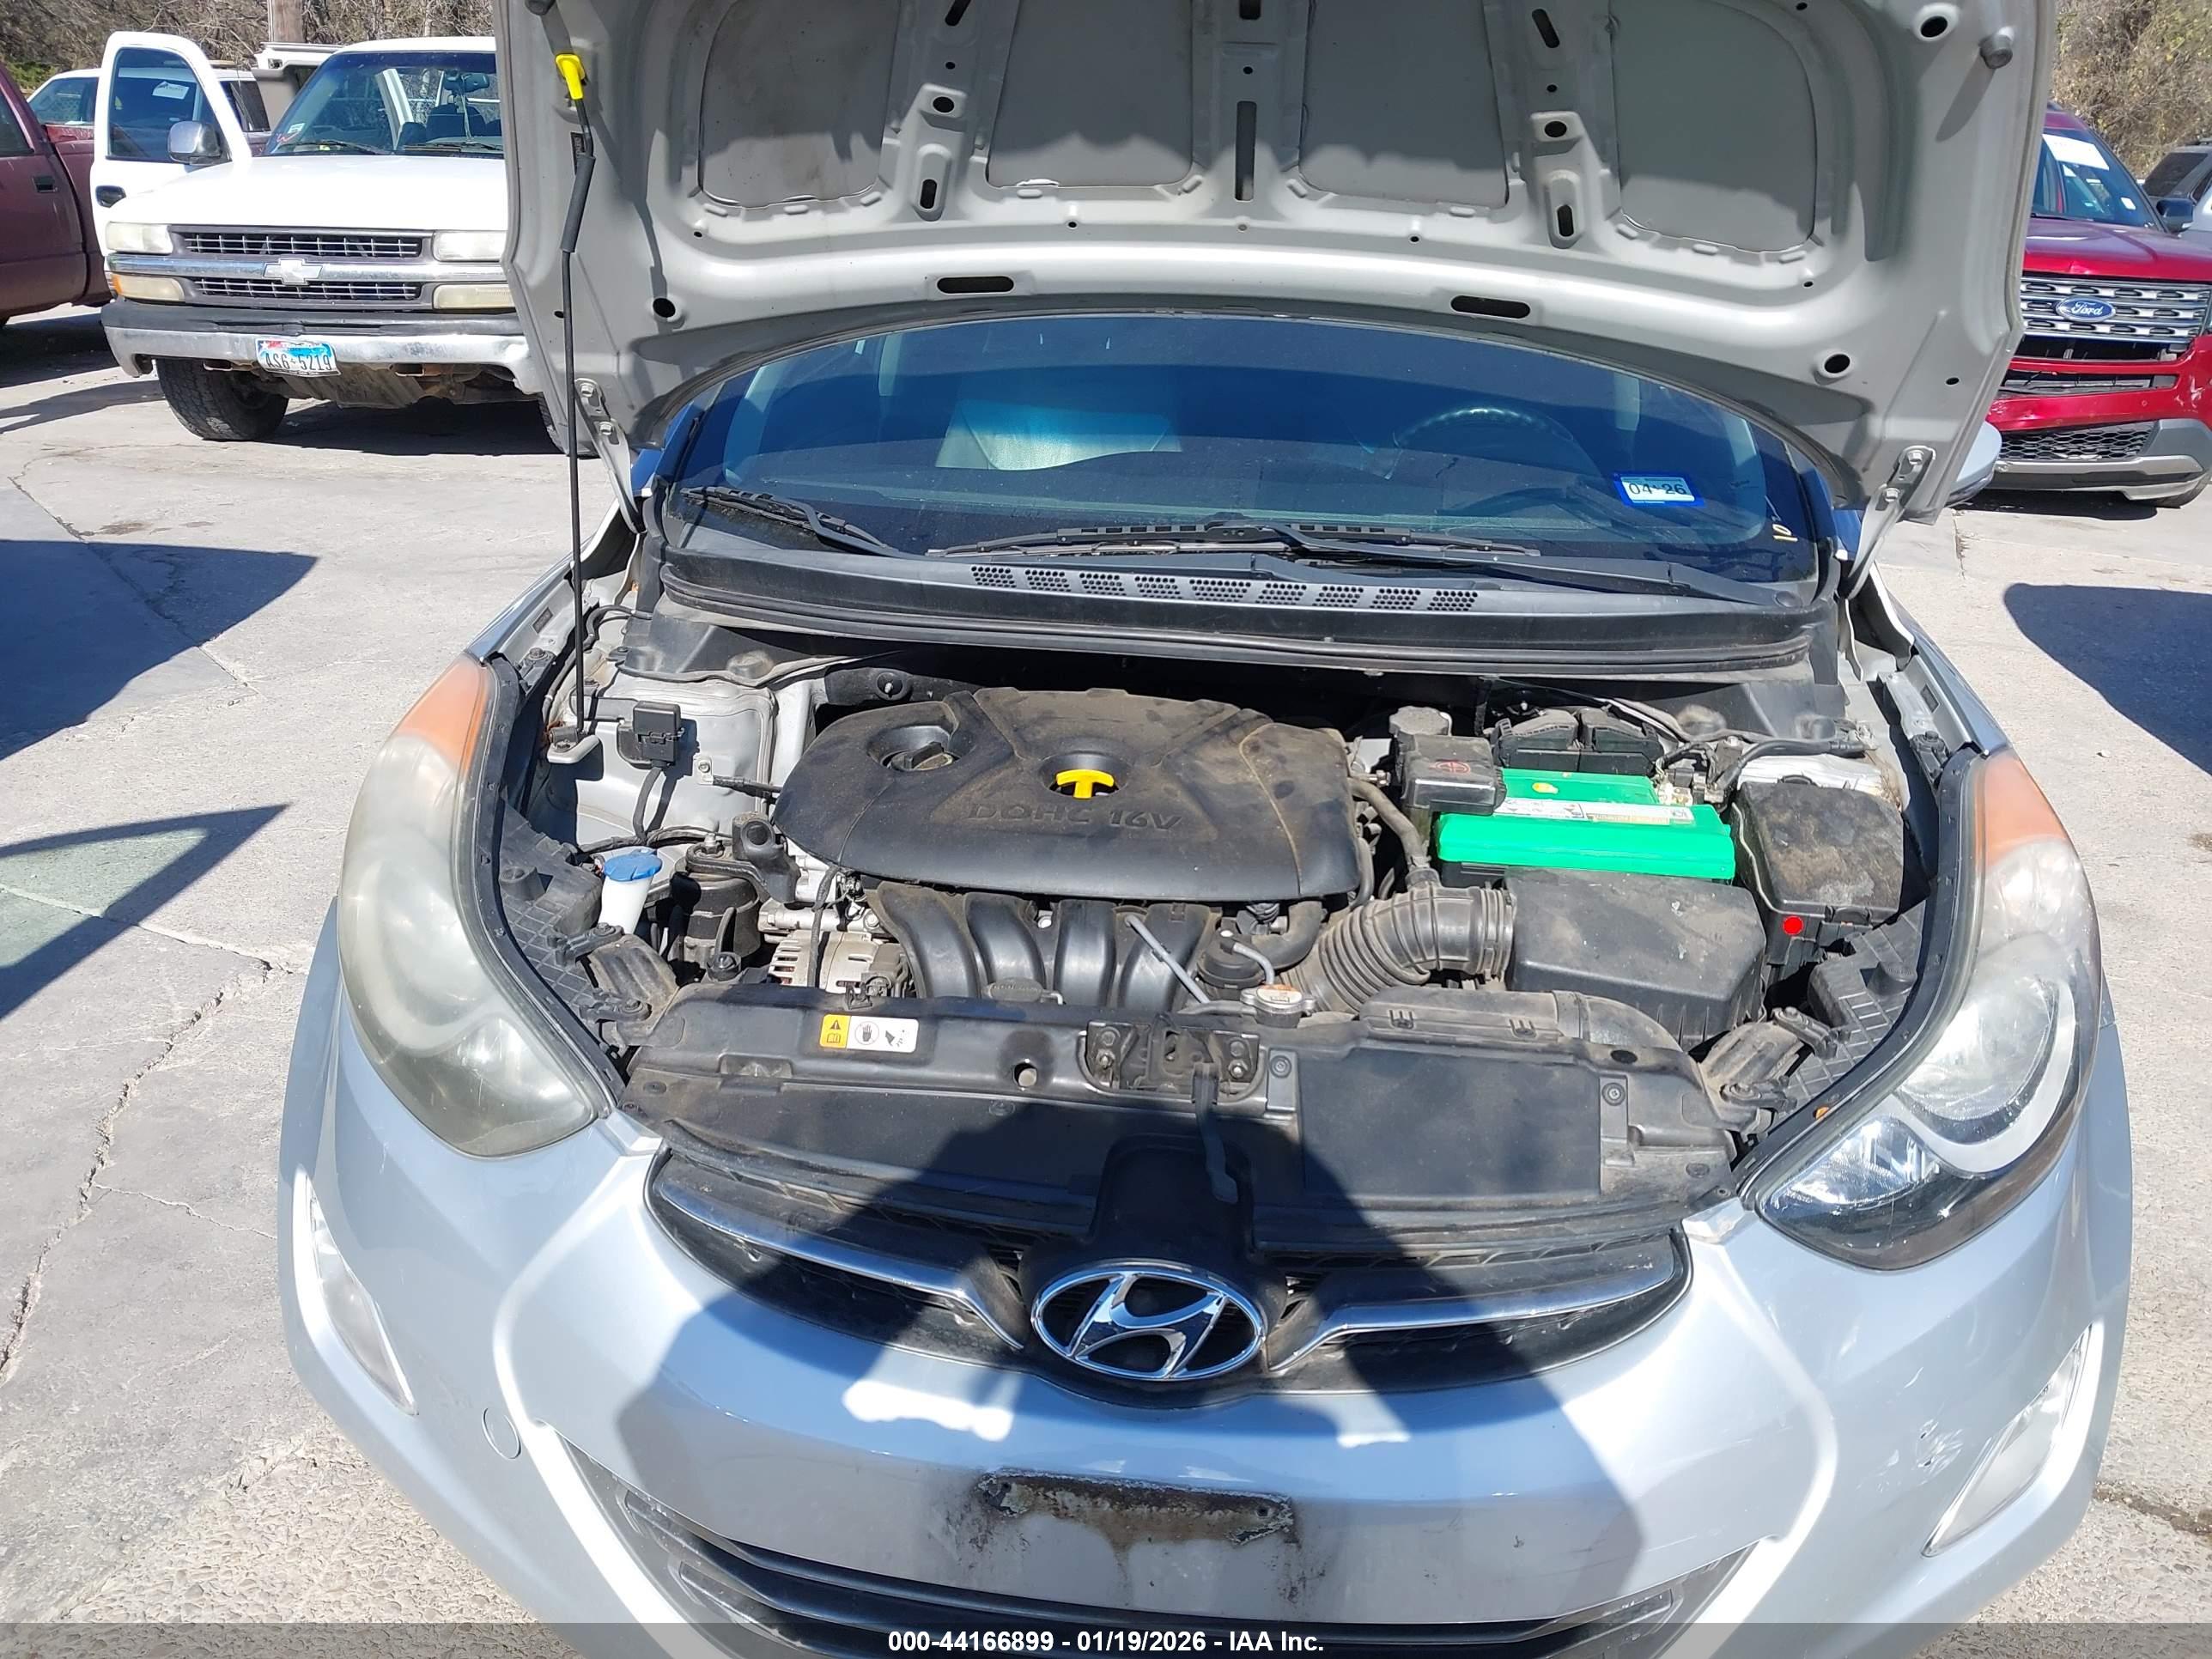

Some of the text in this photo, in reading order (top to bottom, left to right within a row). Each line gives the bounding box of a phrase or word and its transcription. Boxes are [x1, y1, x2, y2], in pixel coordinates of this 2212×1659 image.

[2071, 301, 2104, 316] Ford
[967, 803, 1183, 831] DOHC 16V
